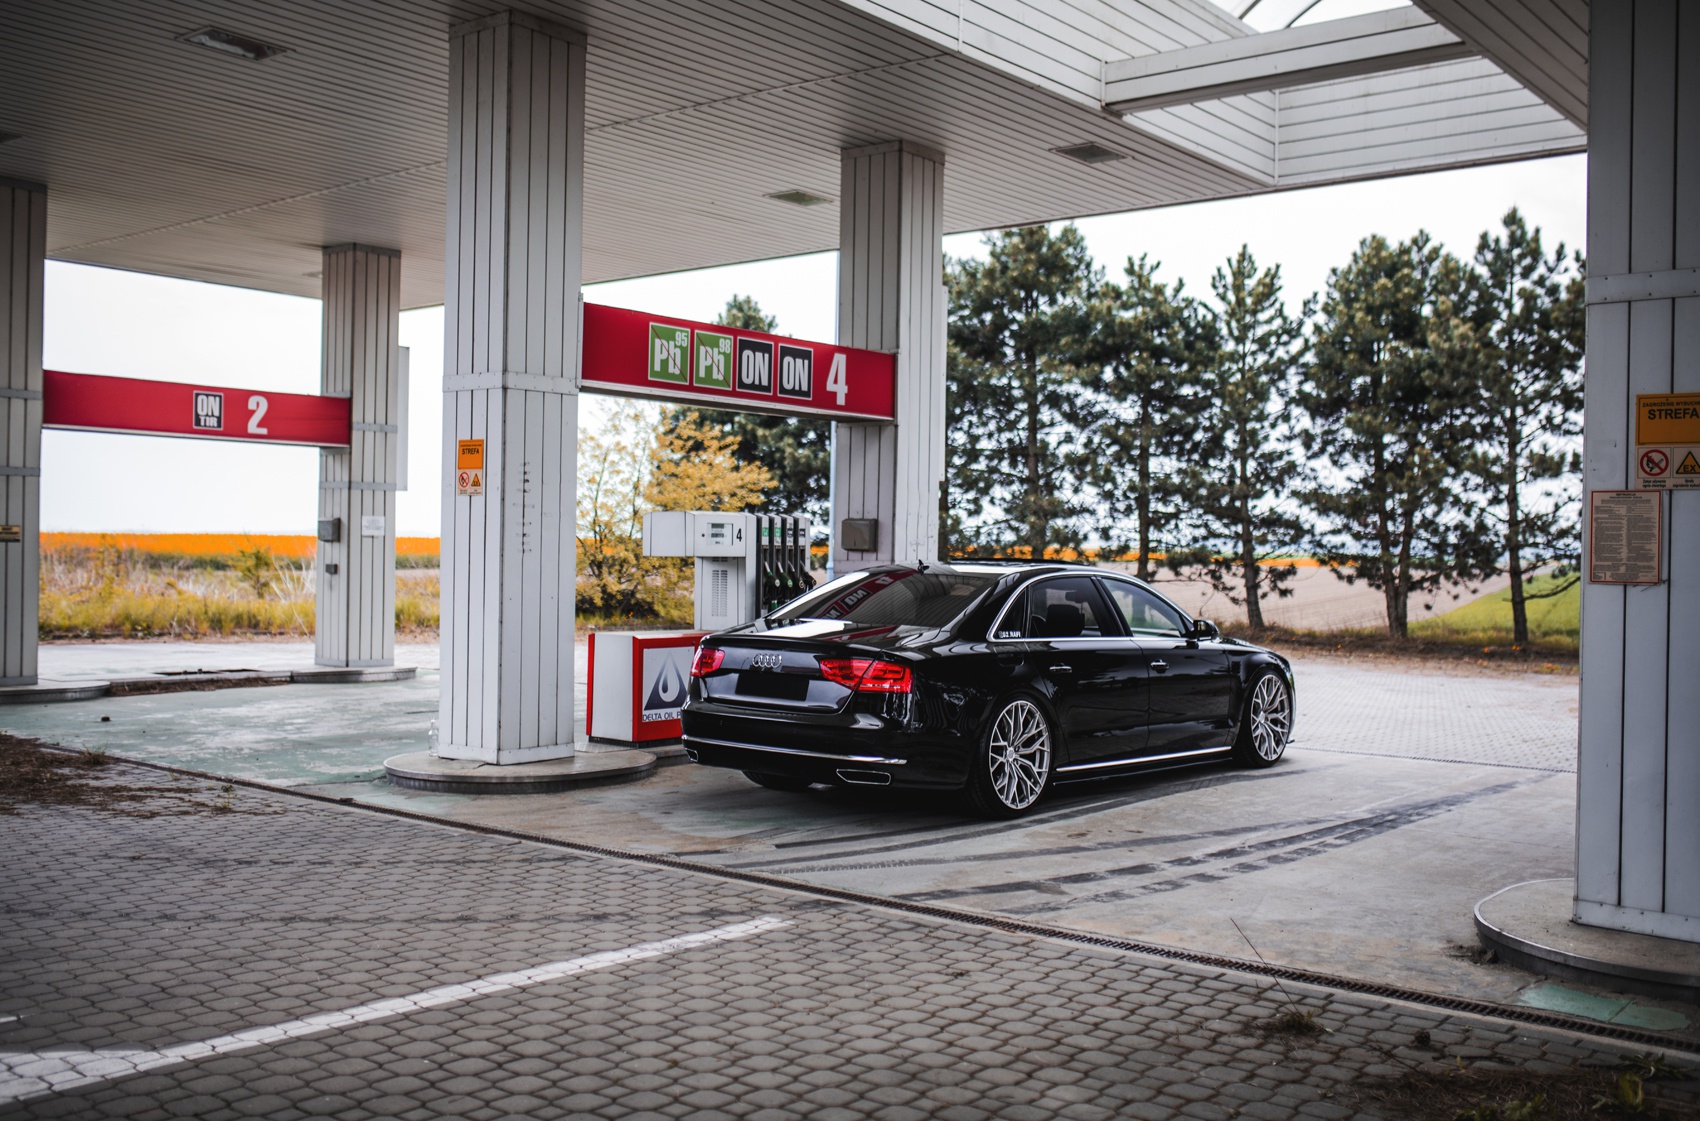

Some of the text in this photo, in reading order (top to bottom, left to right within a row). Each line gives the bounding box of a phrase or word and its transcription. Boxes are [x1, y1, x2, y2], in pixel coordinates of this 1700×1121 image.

[741, 348, 769, 387] ON
[782, 355, 809, 393] ON
[826, 352, 849, 406] 4
[197, 395, 269, 435] ON 2
[1648, 408, 1699, 419] STREFA
[199, 416, 217, 427] TIR
[1683, 465, 1696, 473] EX
[736, 528, 742, 542] 4
[643, 713, 662, 722] DELTA
[664, 711, 674, 719] OIL
